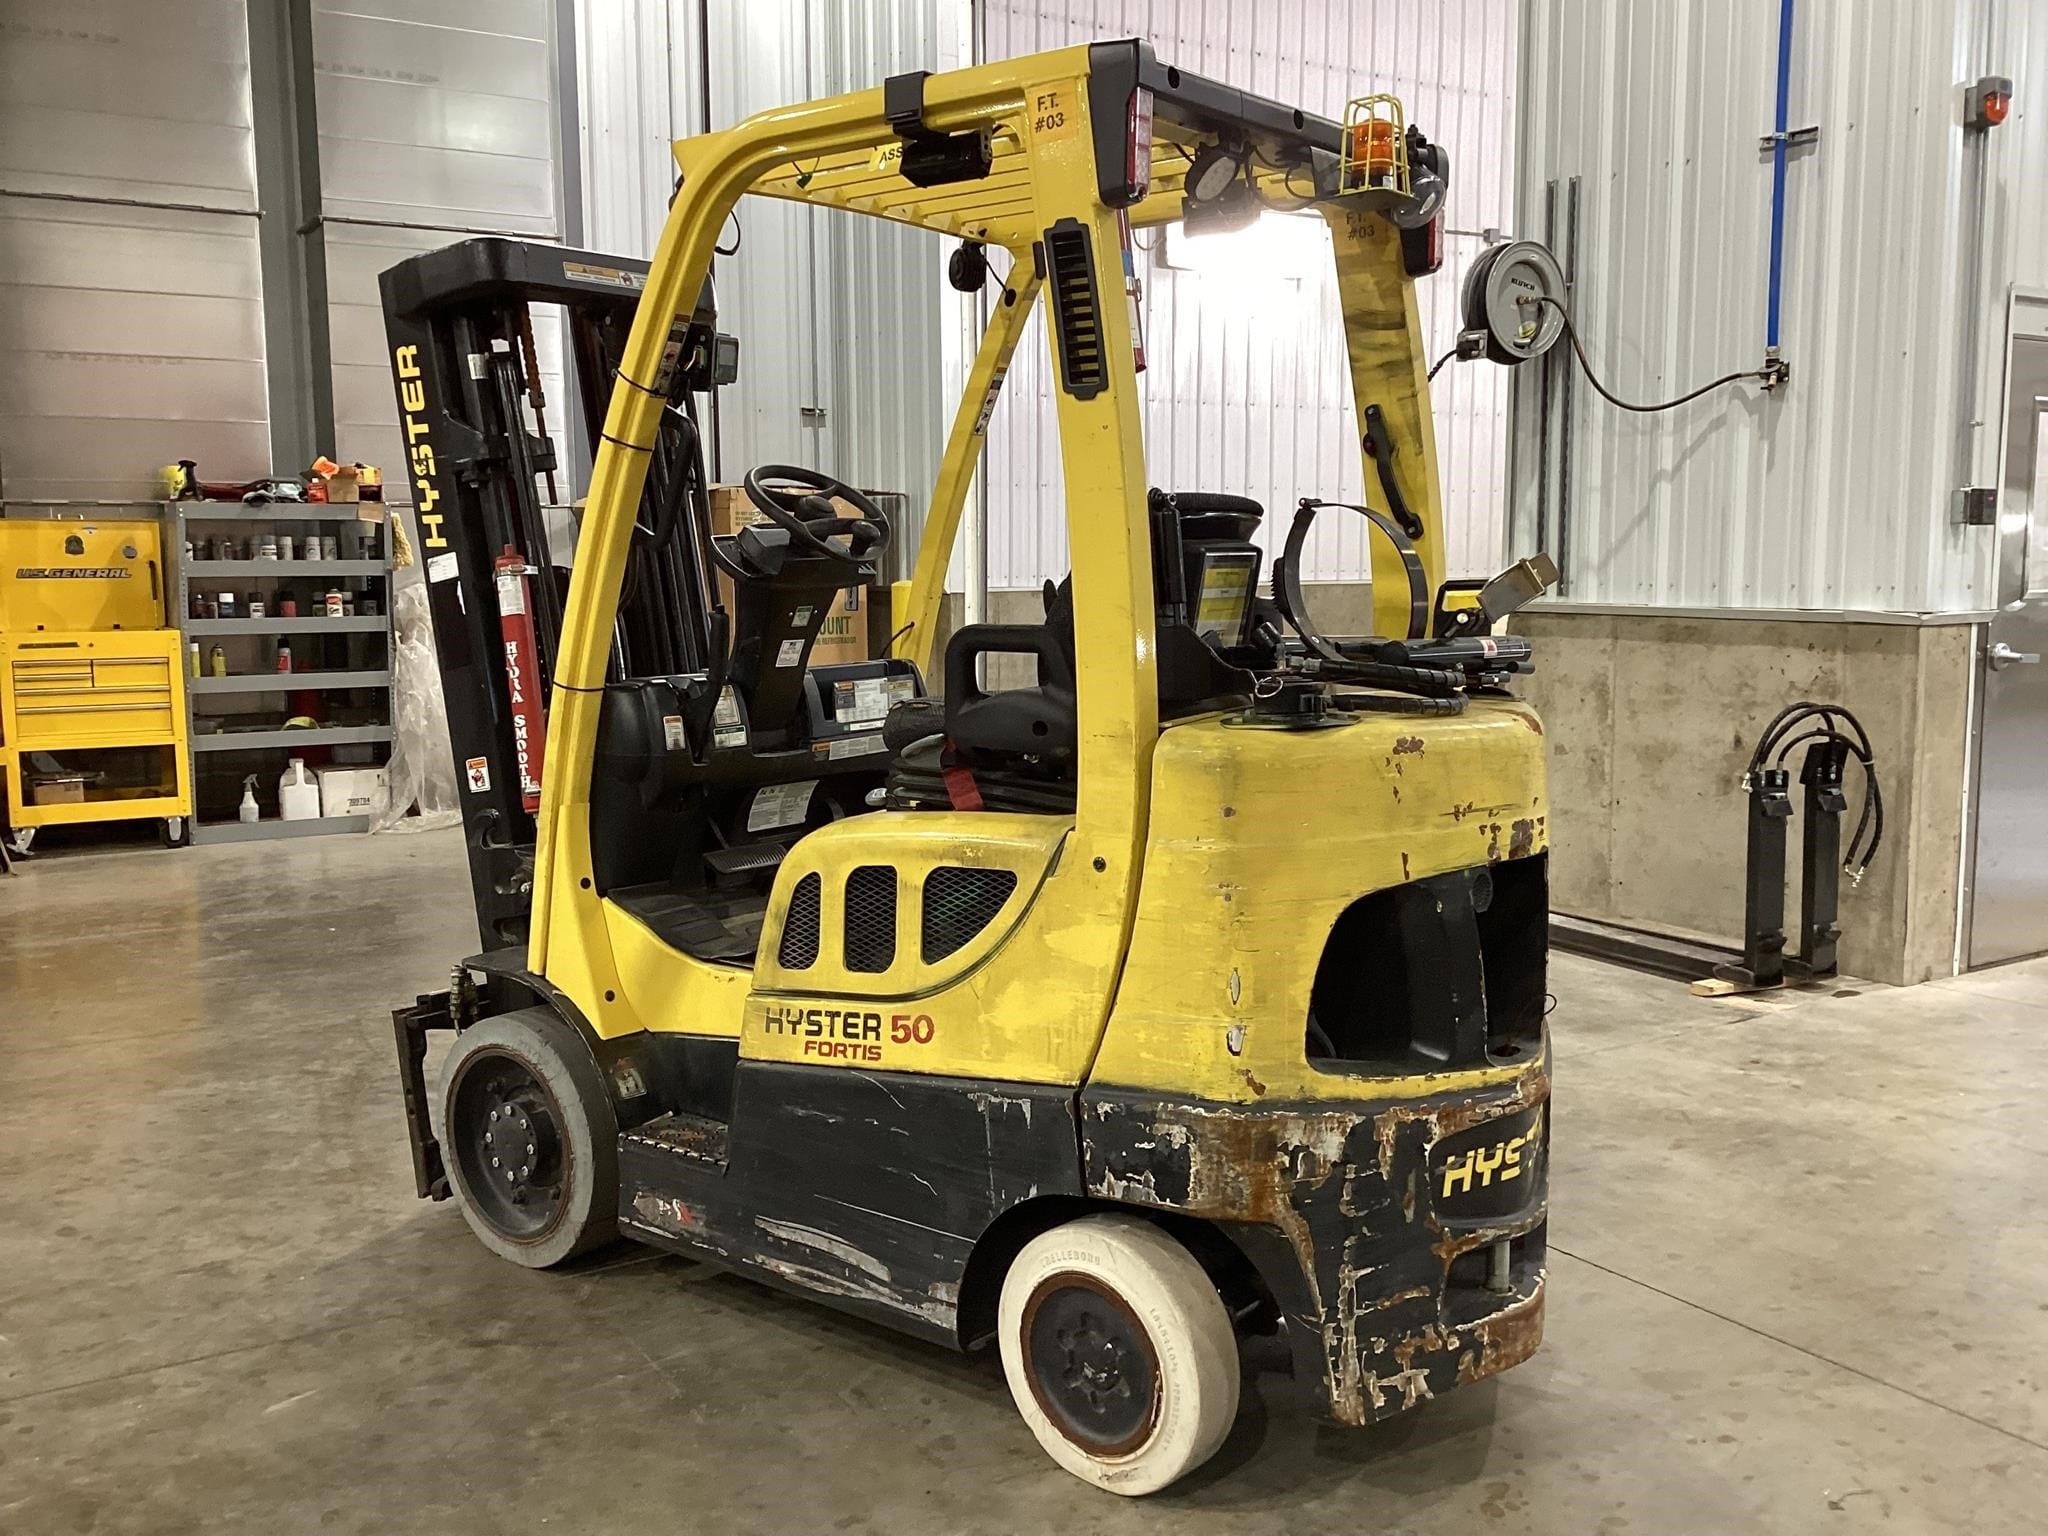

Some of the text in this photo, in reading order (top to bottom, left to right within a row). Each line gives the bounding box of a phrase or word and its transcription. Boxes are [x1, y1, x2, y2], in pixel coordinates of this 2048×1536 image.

[1037, 93, 1060, 113] F.T.
[1034, 112, 1065, 134] #03
[1347, 225, 1375, 240] #03
[396, 345, 448, 548] HYSTER
[48, 568, 131, 578] GENERAL
[513, 714, 532, 788] SMOOTH
[765, 1006, 935, 1044] HYSTER 50
[804, 1040, 882, 1062] FORTIS
